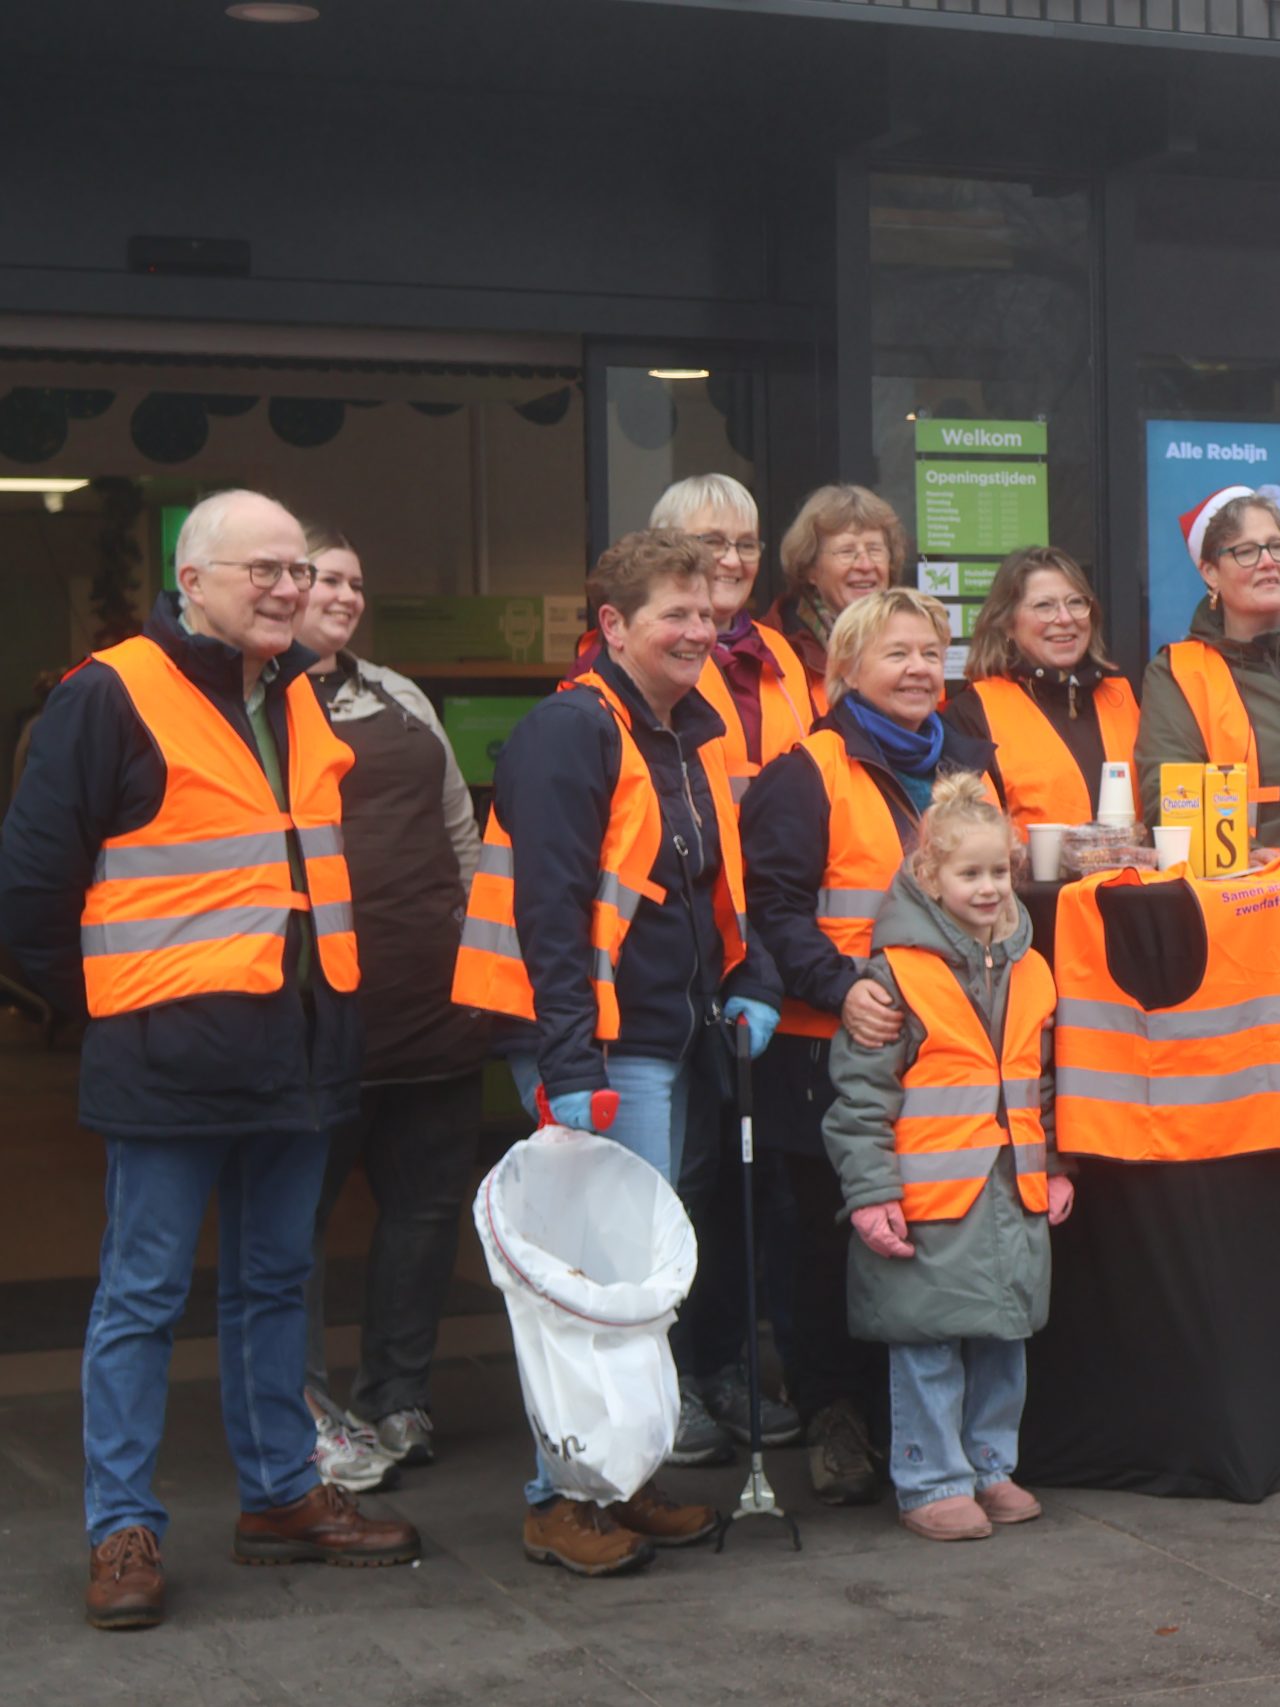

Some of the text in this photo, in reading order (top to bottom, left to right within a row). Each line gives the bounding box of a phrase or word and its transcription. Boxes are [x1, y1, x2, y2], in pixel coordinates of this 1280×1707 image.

[942, 428, 1023, 447] Welkom
[1165, 442, 1267, 463] Alle Robijn
[925, 470, 1037, 487] Openingstijden
[1215, 818, 1237, 869] S
[1222, 887, 1265, 903] Samen
